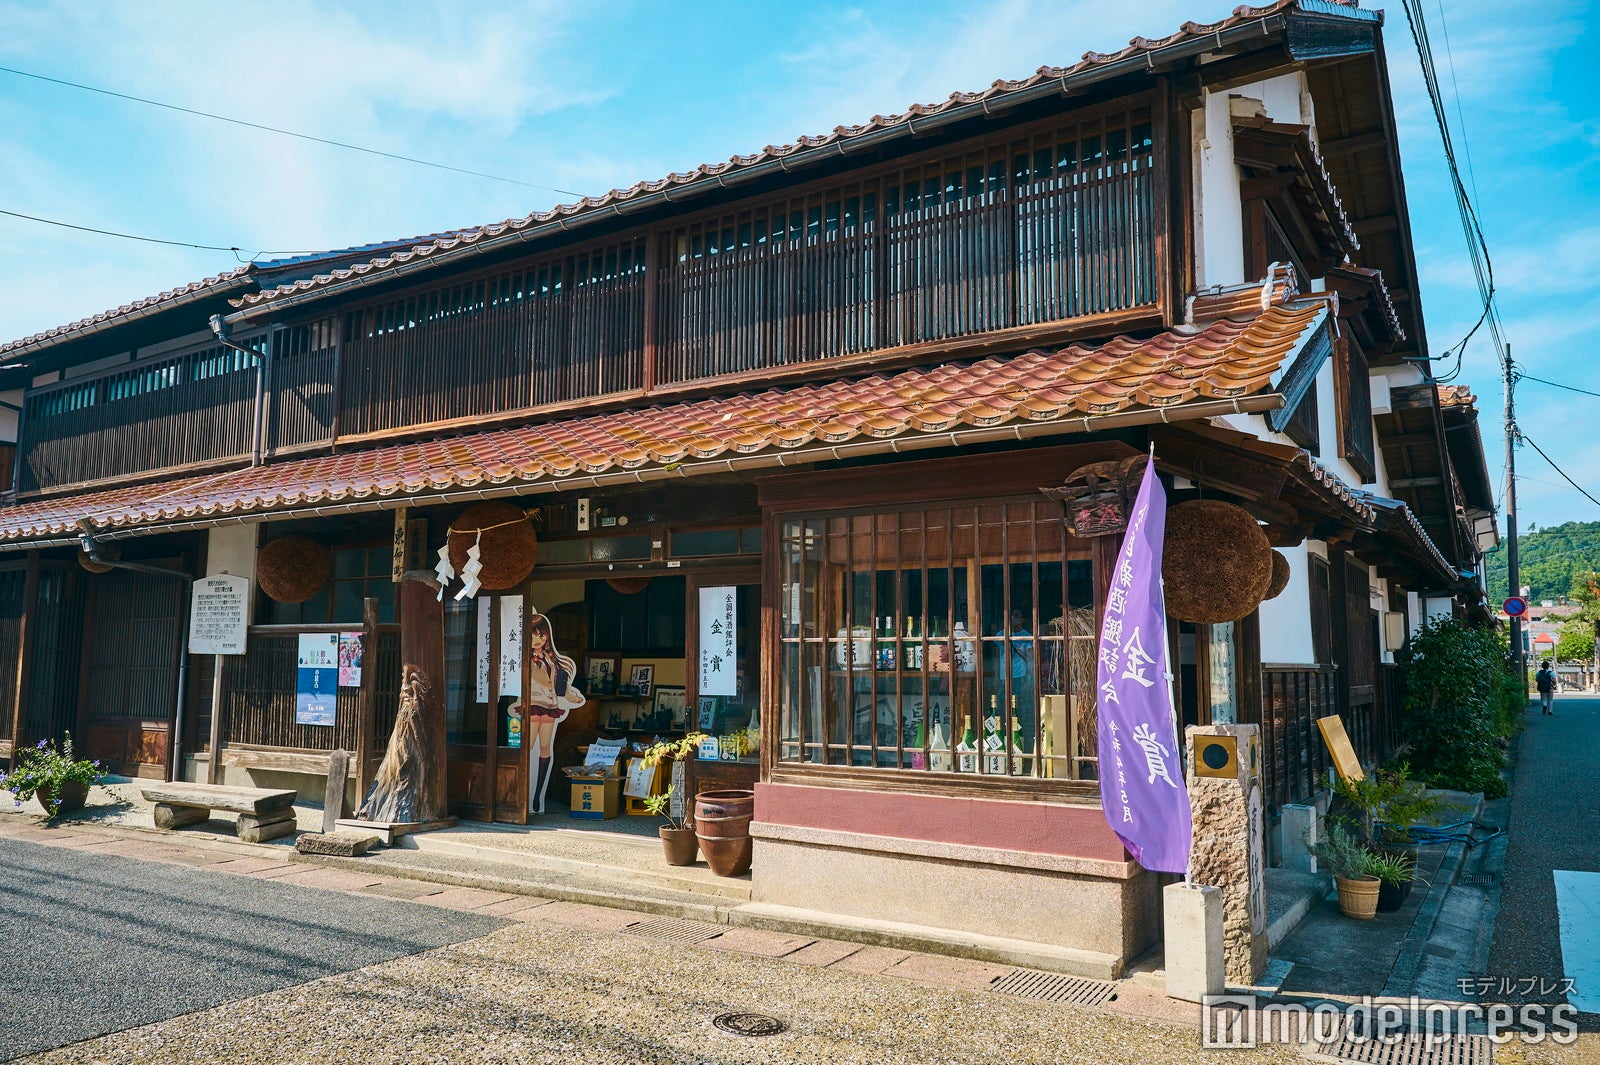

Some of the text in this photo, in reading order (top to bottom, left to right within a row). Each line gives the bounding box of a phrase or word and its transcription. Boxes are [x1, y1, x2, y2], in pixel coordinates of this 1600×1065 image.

[508, 628, 517, 673] 金賞
[710, 618, 723, 672] 金賞
[725, 593, 733, 657] 全国新酒鑑評会
